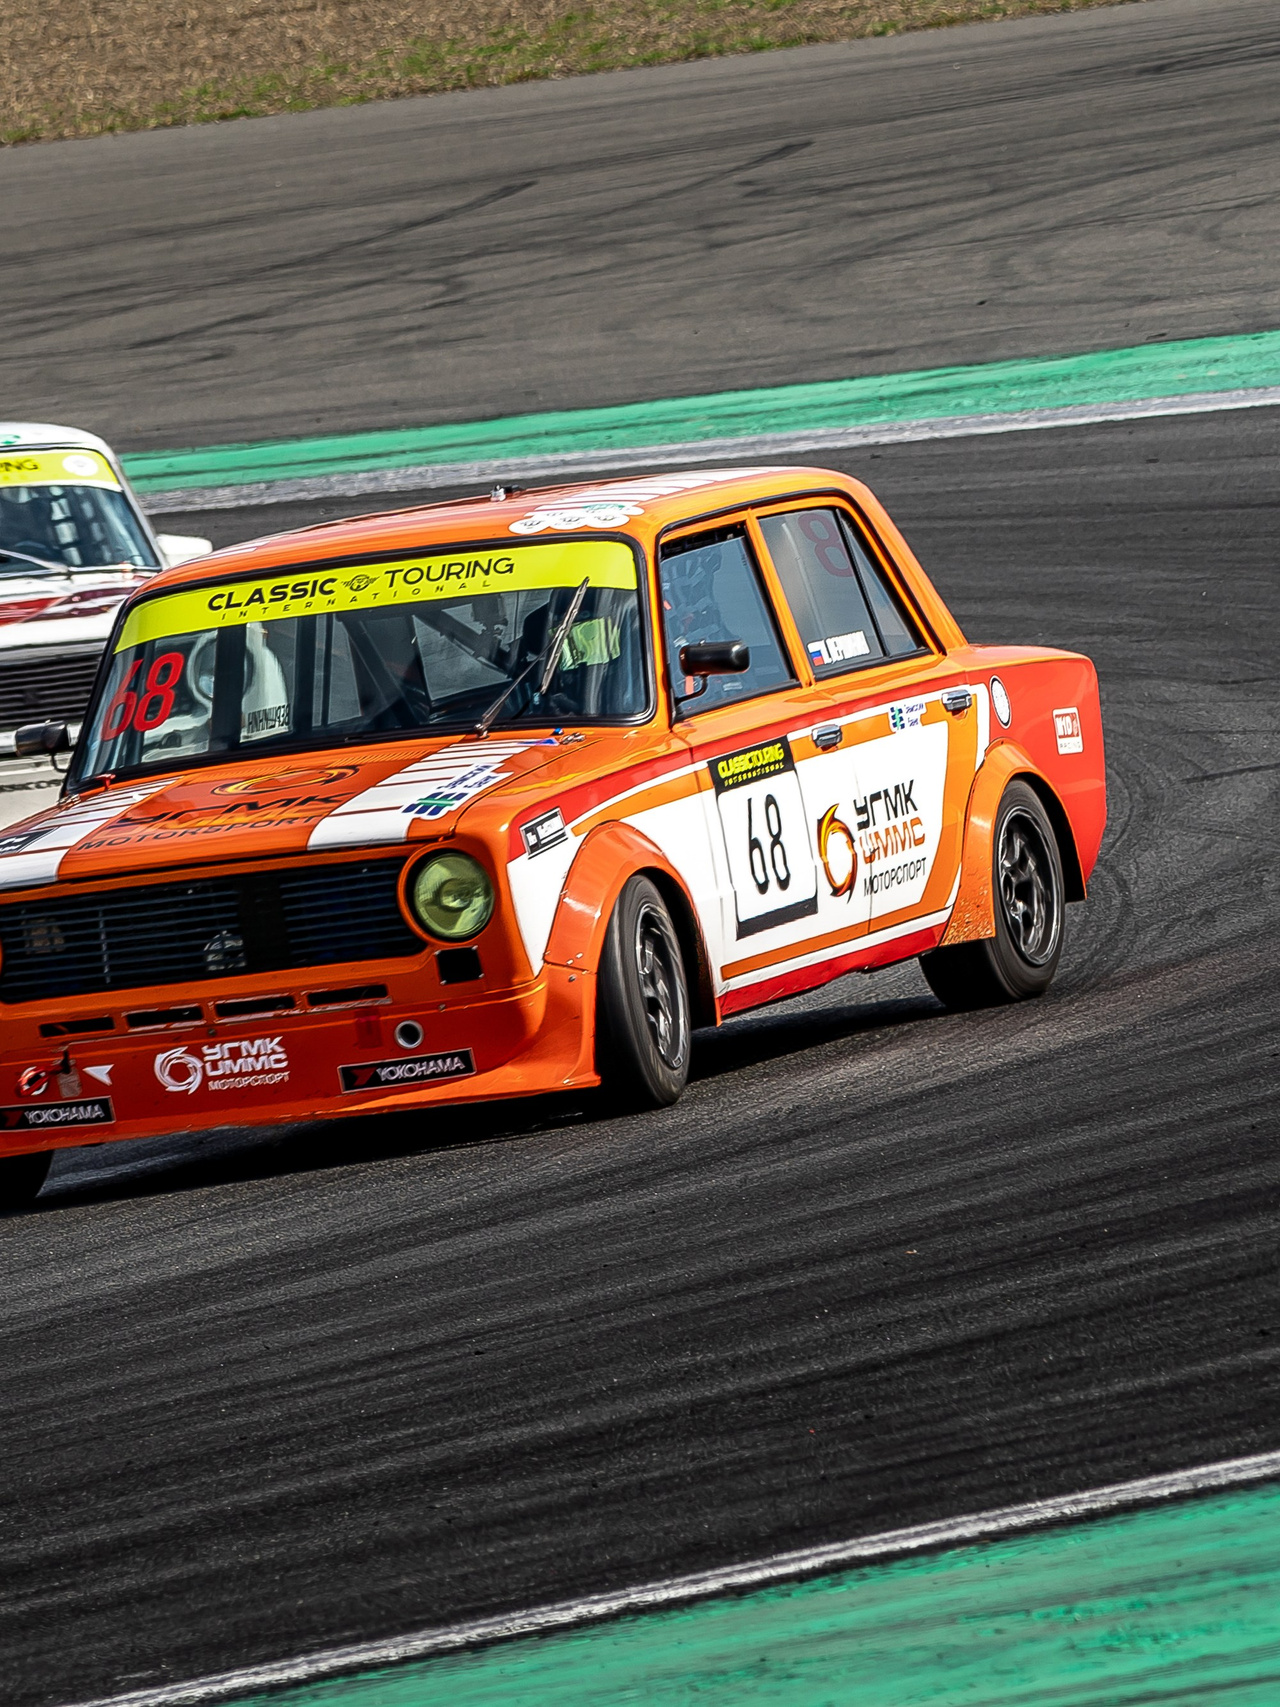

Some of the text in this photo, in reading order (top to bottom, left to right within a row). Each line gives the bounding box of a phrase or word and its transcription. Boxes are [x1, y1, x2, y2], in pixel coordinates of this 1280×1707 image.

[206, 556, 516, 612] CLASSIC TOURING
[220, 579, 492, 621] INTERNATIONAL
[101, 650, 186, 742] 68
[853, 779, 919, 832] УГМК
[75, 814, 322, 852] MOTORSPORT
[747, 793, 791, 896] 68
[858, 816, 926, 865] UMMC
[863, 856, 927, 898] МОТОРСПОРТ
[201, 1035, 286, 1062] УГМК
[205, 1052, 289, 1077] UMMC
[376, 1056, 466, 1082] YOKOHAMA
[207, 1070, 291, 1092] МОТОРСПОРТ
[24, 1104, 105, 1125] YOKOHAMA
